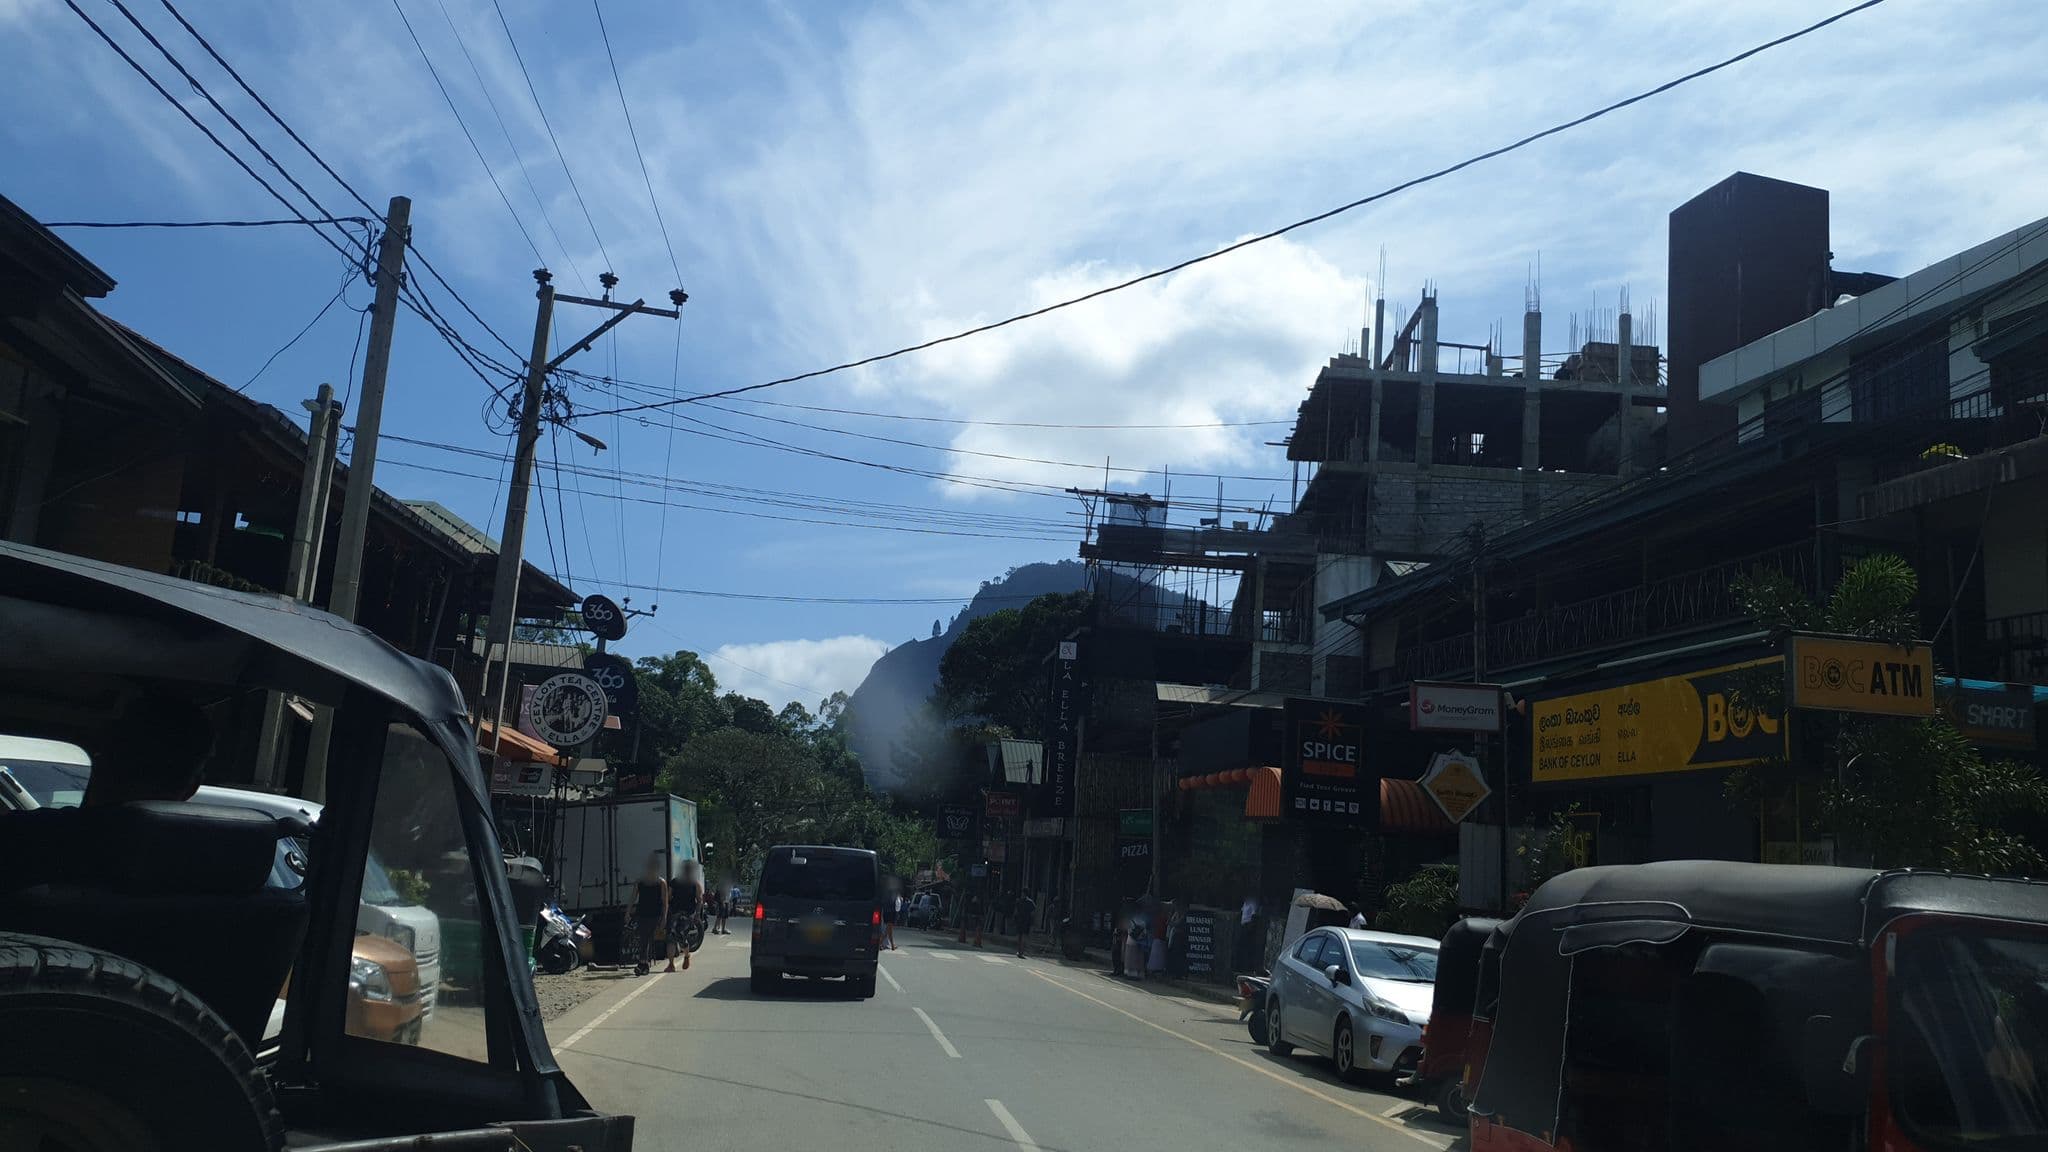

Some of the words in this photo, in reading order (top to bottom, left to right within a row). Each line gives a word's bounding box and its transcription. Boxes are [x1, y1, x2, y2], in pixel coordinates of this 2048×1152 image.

[585, 603, 614, 621] 360
[592, 667, 625, 689] 360
[1062, 661, 1072, 681] LA
[1803, 655, 1865, 693] BOC
[1870, 661, 1923, 699] ATM
[532, 681, 557, 725] CEYLON
[560, 676, 583, 686] TEA
[586, 684, 603, 730] CENTRE
[1059, 689, 1069, 731] ELLA
[1437, 703, 1495, 717] MoneyGram
[1968, 703, 2029, 729] SMART
[548, 733, 580, 743] ELLA
[1303, 741, 1357, 762] SPICE
[1538, 756, 1559, 771] BANK
[1559, 754, 1569, 769] OF
[1571, 751, 1601, 768] CEYLON
[1617, 751, 1637, 763] ELLA
[1055, 741, 1066, 806] BREEZE
[1121, 843, 1149, 857] PIZZA
[1190, 944, 1210, 952] PIZZA
